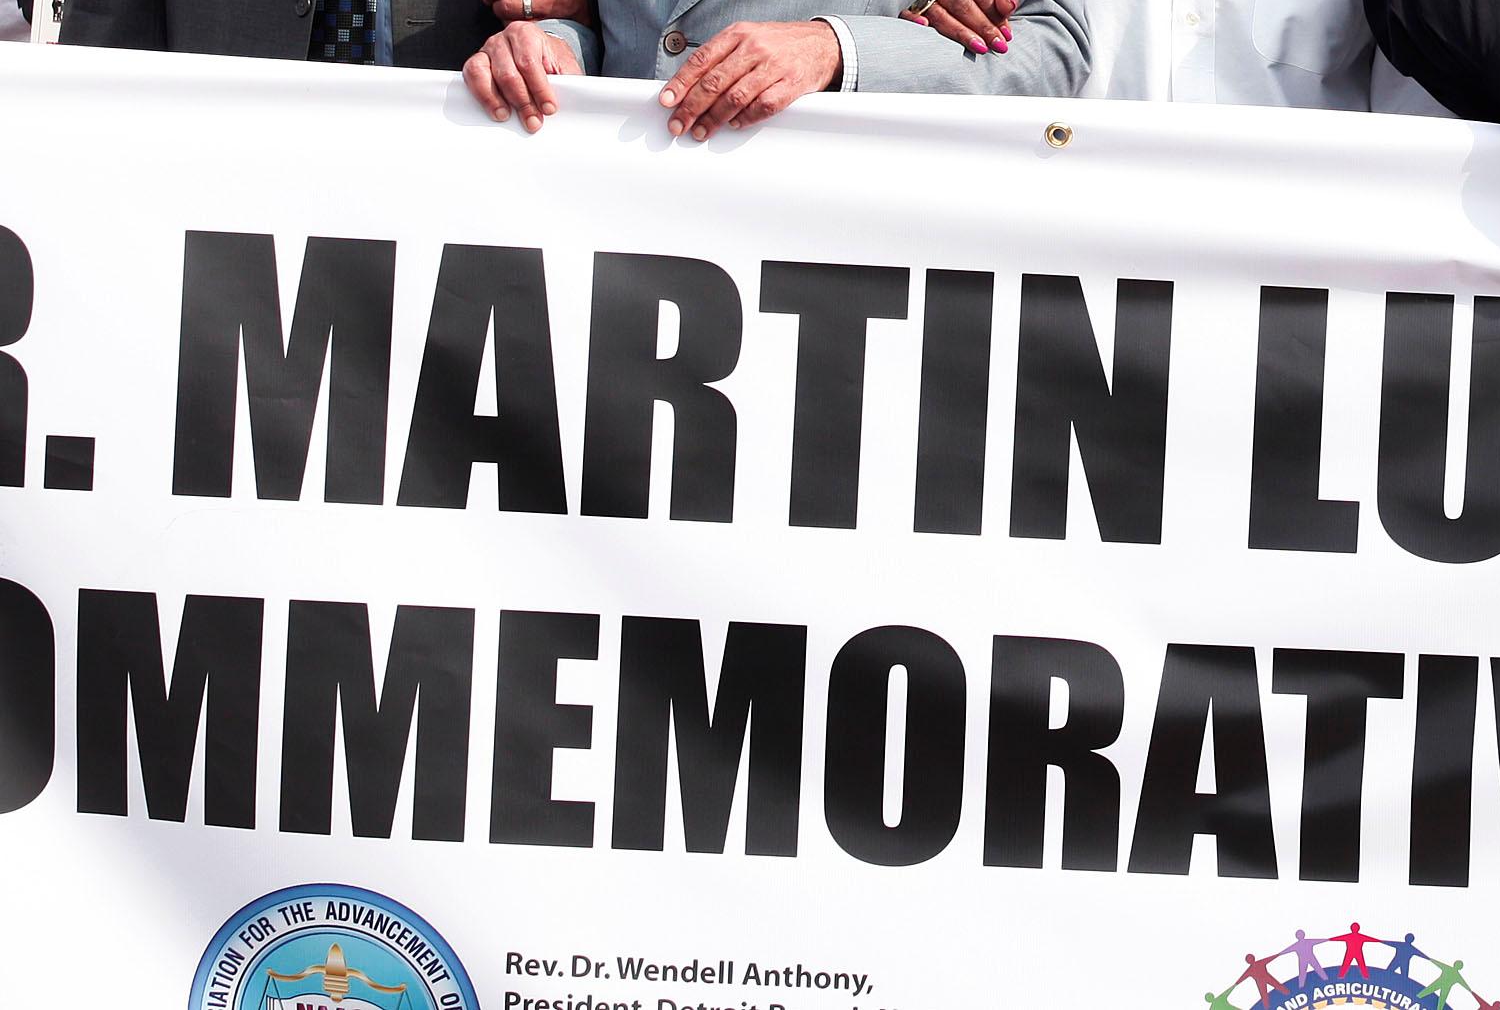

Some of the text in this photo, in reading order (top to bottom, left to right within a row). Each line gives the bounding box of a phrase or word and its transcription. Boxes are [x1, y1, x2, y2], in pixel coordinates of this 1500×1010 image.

[172, 230, 1174, 544] MARTIN
[239, 917, 276, 950] FOR
[277, 901, 316, 926] THE
[326, 901, 451, 985] ADVANCEMENT
[506, 952, 874, 996] Rev. Dr. Wendell Anthony,
[1313, 983, 1427, 1010] AGRICULTURA
